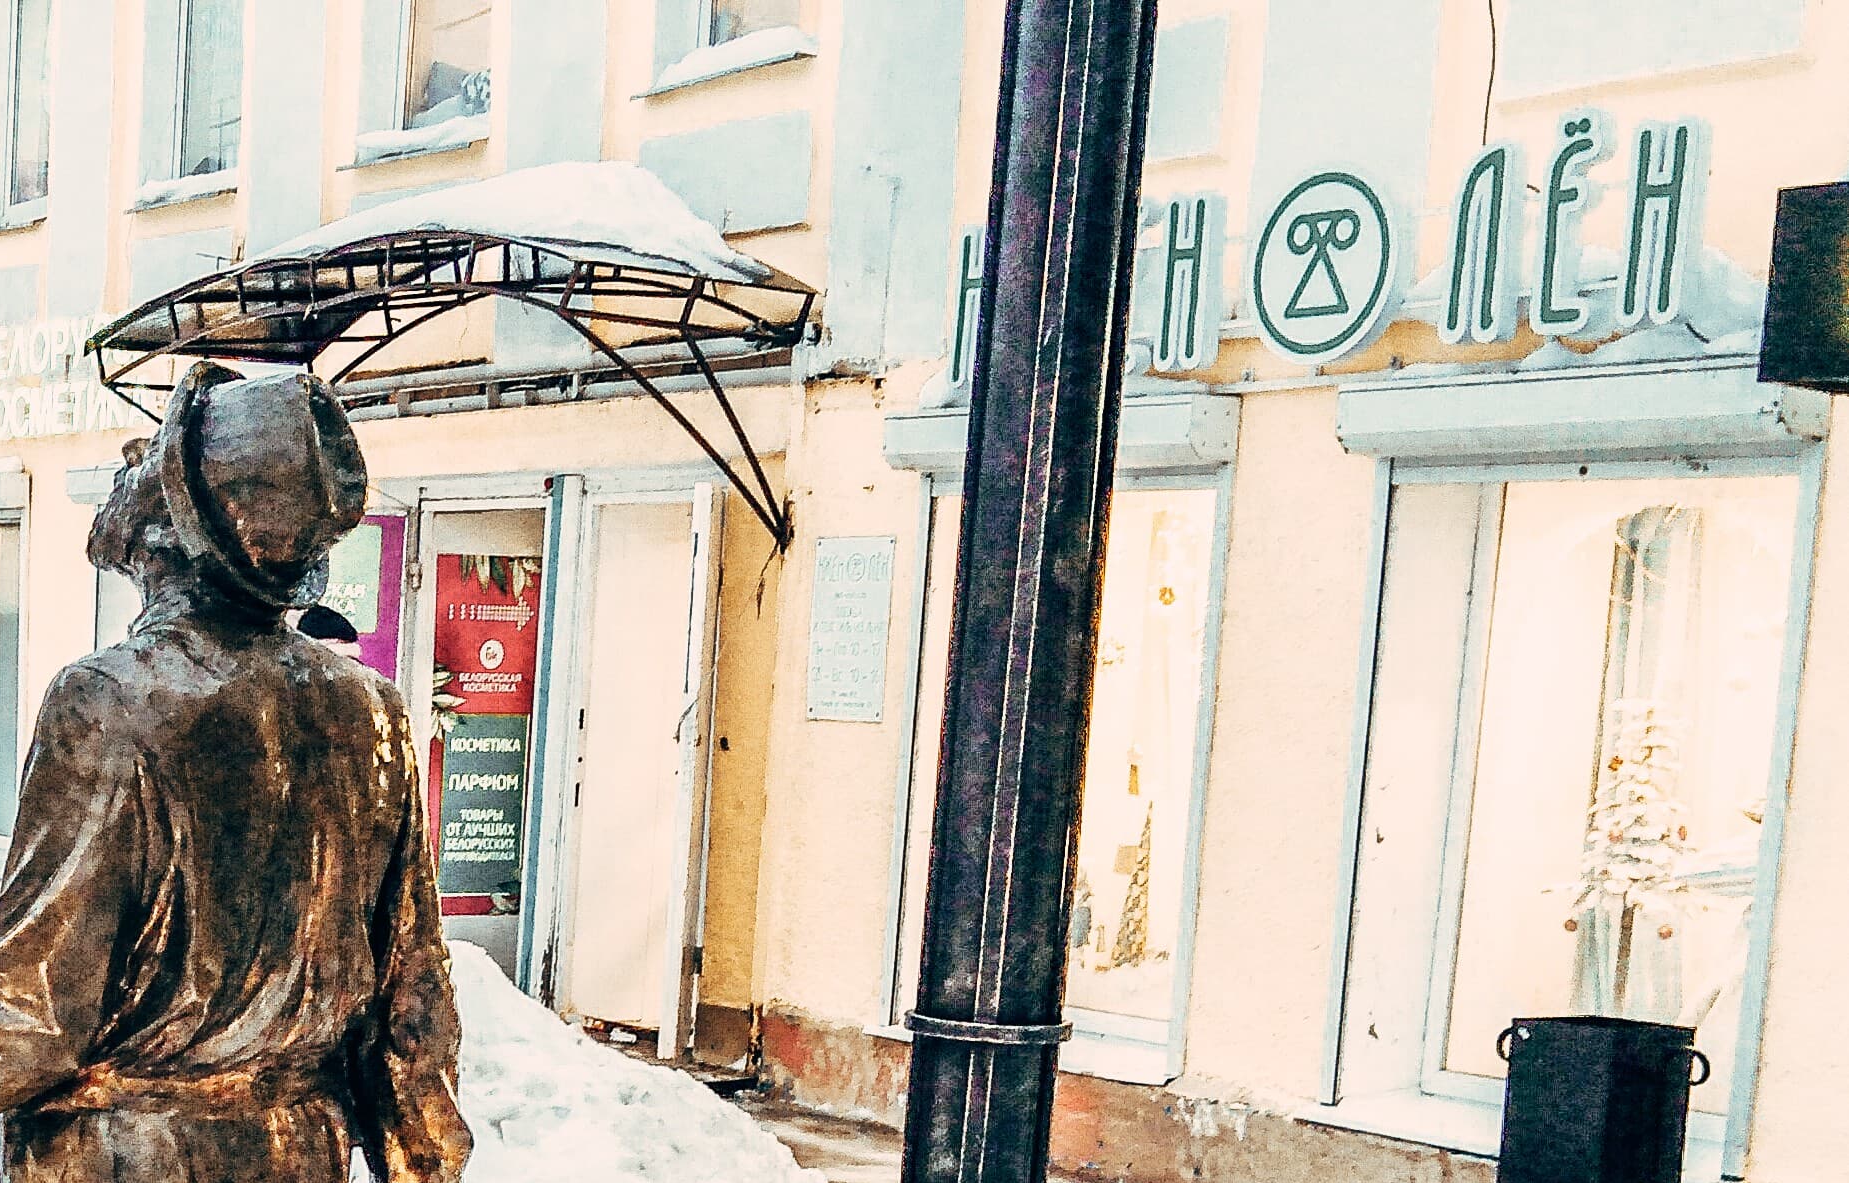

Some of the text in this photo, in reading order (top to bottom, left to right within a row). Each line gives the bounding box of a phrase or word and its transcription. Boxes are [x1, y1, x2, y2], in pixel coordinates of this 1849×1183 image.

[1445, 116, 1691, 332] ЛЁН
[459, 672, 522, 682] БЕЛОРУССКАЯ
[462, 682, 517, 692] КОСМЕТИКА
[450, 738, 521, 752] КОСМЕТИКА
[448, 774, 519, 791] ПАРФЮМ
[460, 809, 504, 821] ТОВАРЫ
[445, 822, 516, 837] ОТ ЛУЧШИХ
[445, 838, 515, 850] БЕЛОРУССКИХ
